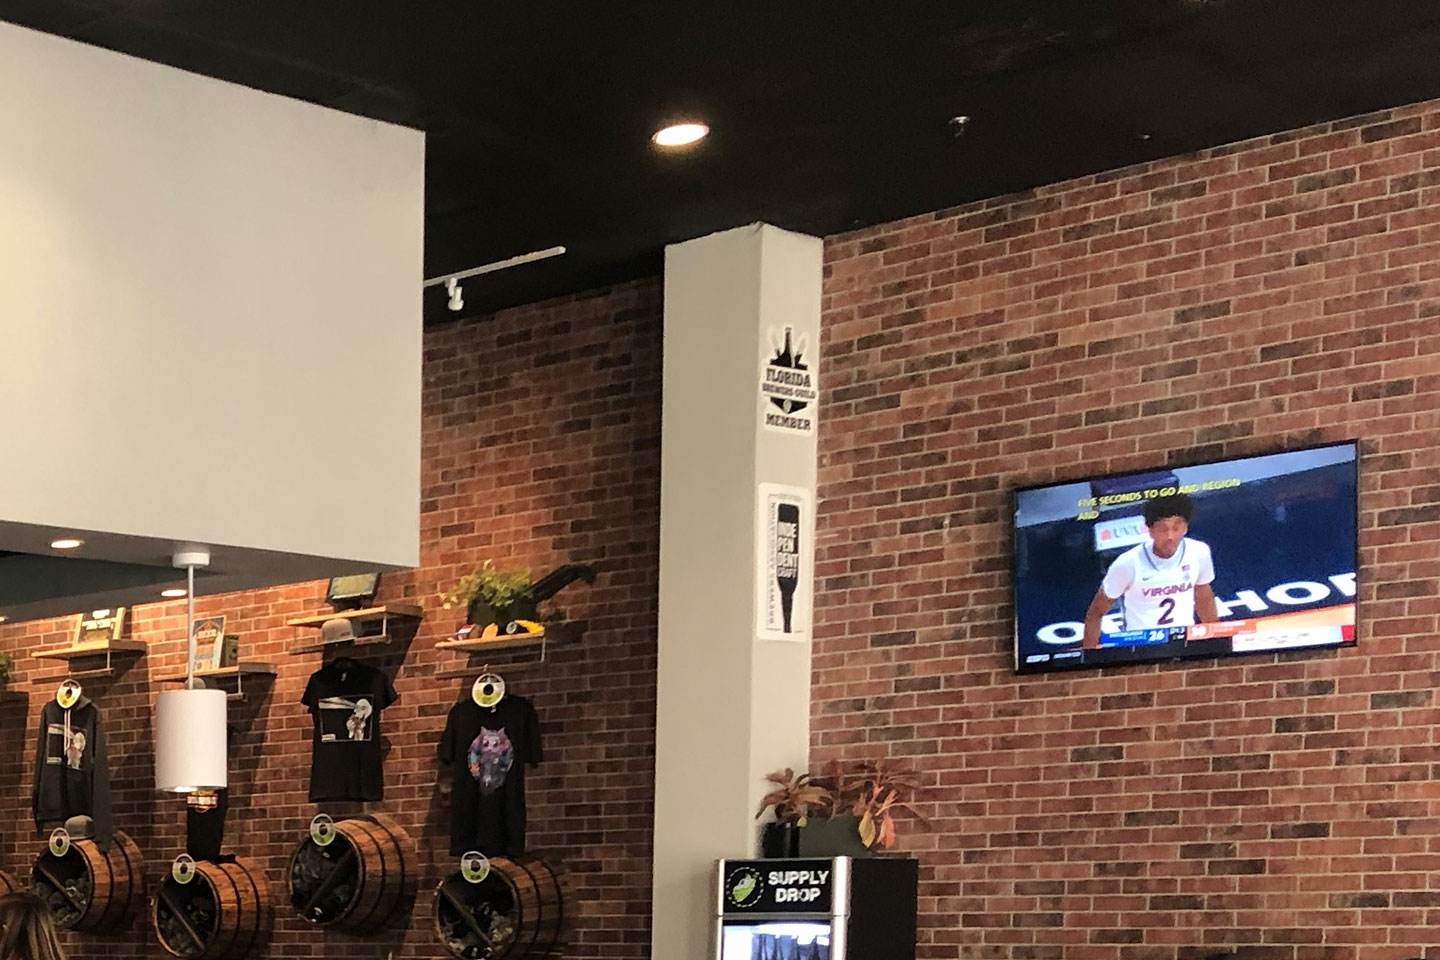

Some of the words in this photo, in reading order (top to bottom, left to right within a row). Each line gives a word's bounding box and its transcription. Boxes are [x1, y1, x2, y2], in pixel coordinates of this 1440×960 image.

[766, 368, 811, 387] FLORIDA
[766, 413, 811, 431] MEMBER
[1078, 499, 1098, 507] FIVE
[1098, 491, 1142, 505] SECONDS
[1144, 489, 1158, 498] TO
[1160, 487, 1176, 496] GO
[1077, 511, 1099, 521] AND
[1142, 582, 1194, 598] VIRGINIA
[1158, 597, 1175, 625] 2
[1148, 630, 1165, 642] 26
[768, 870, 829, 885] SUPPLY
[775, 887, 821, 903] DROP
